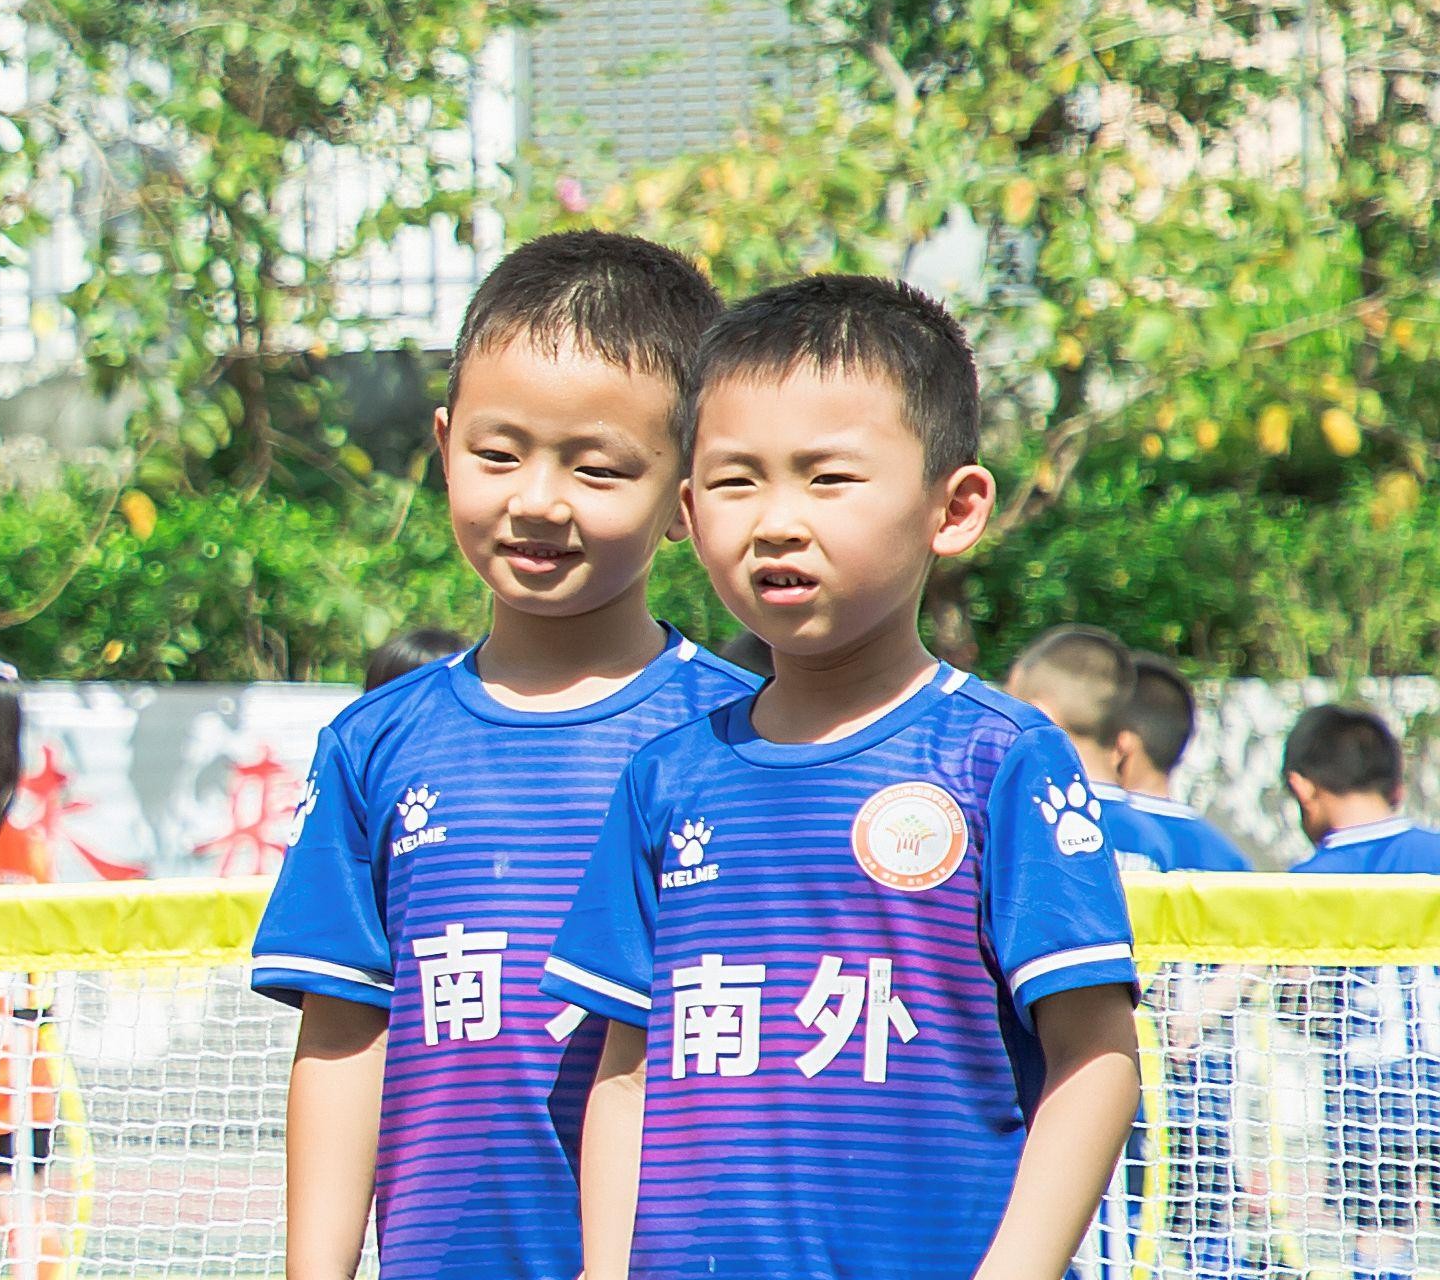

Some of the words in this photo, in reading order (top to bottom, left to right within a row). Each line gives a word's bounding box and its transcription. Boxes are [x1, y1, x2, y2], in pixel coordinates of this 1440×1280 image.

[392, 826, 448, 857] KELME
[661, 864, 720, 889] KELME
[672, 954, 919, 1083] 南外
